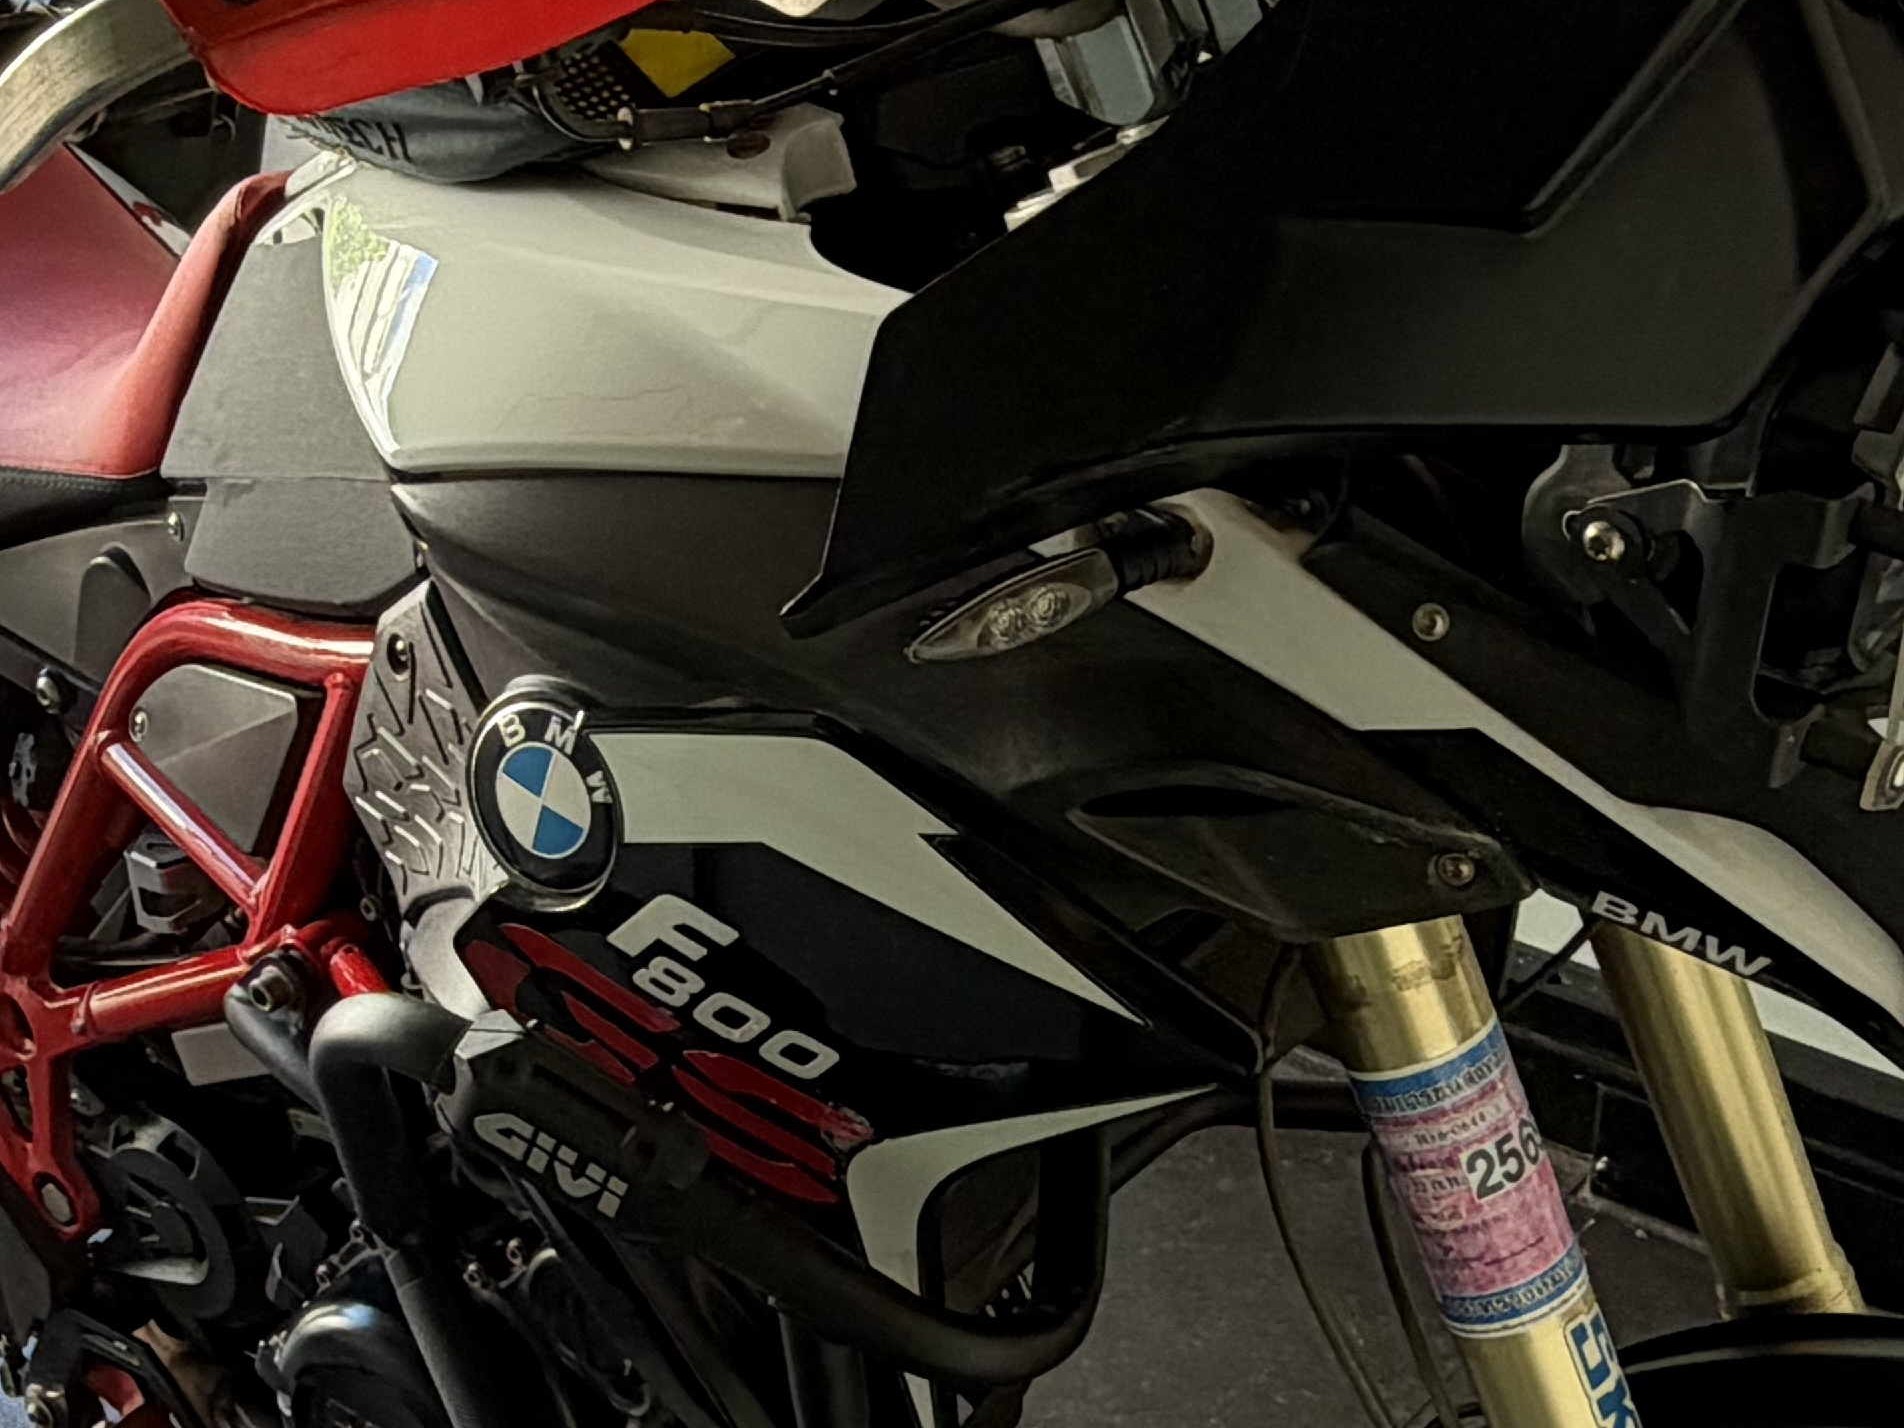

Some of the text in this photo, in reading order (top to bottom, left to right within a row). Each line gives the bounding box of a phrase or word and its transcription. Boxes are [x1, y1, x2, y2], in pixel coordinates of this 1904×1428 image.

[497, 713, 614, 804] BMW
[1591, 891, 1771, 978] BMW
[474, 1112, 628, 1218] GIVI
[1465, 1119, 1546, 1200] 256
